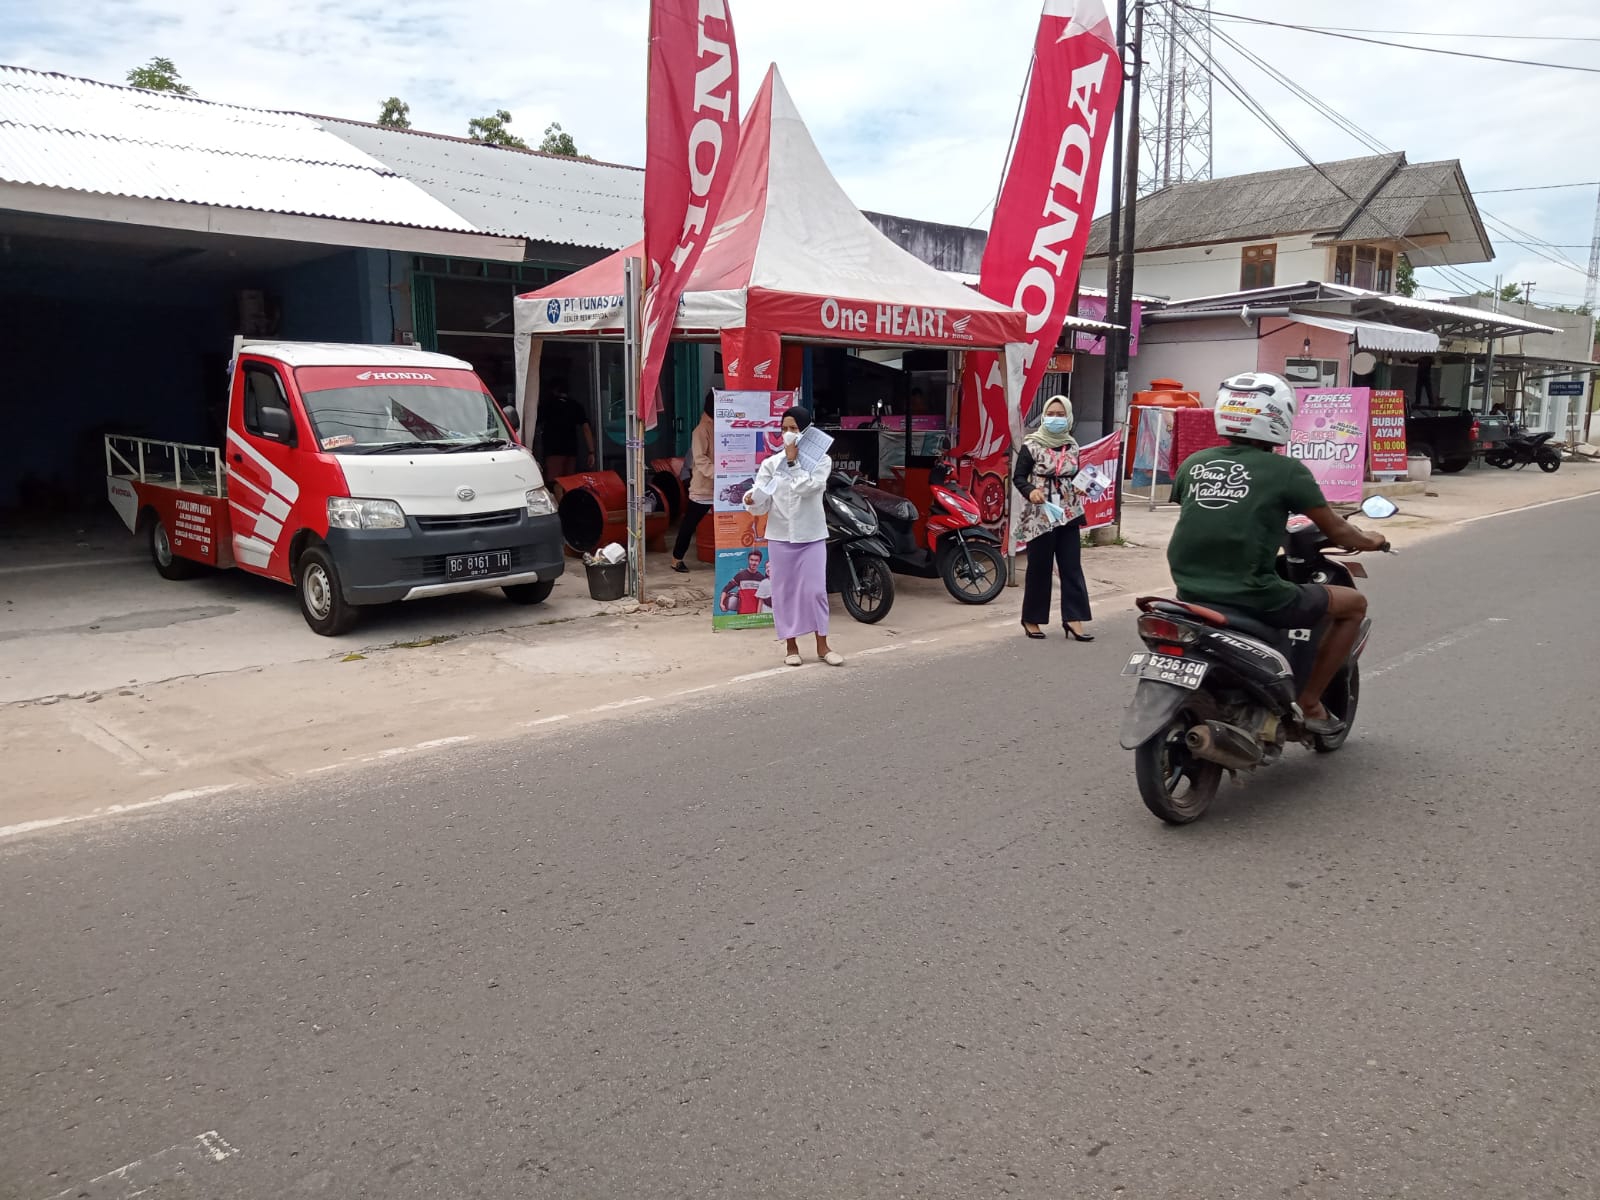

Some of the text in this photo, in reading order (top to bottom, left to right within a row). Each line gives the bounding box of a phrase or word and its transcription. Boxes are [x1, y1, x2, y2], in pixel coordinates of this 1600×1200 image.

[579, 297, 609, 311] TUNAS
[820, 298, 950, 340] One HEART.
[371, 372, 437, 381] HONDA
[1304, 393, 1353, 403] EXPRESS
[1372, 417, 1405, 427] BUBUR
[1375, 428, 1402, 438] AYAM
[1383, 441, 1406, 450] 10.000
[1189, 463, 1252, 486] Deus Ex
[1187, 481, 1250, 503] Machina
[450, 554, 508, 572] BG 8161 IH
[1149, 655, 1181, 671] 6236
